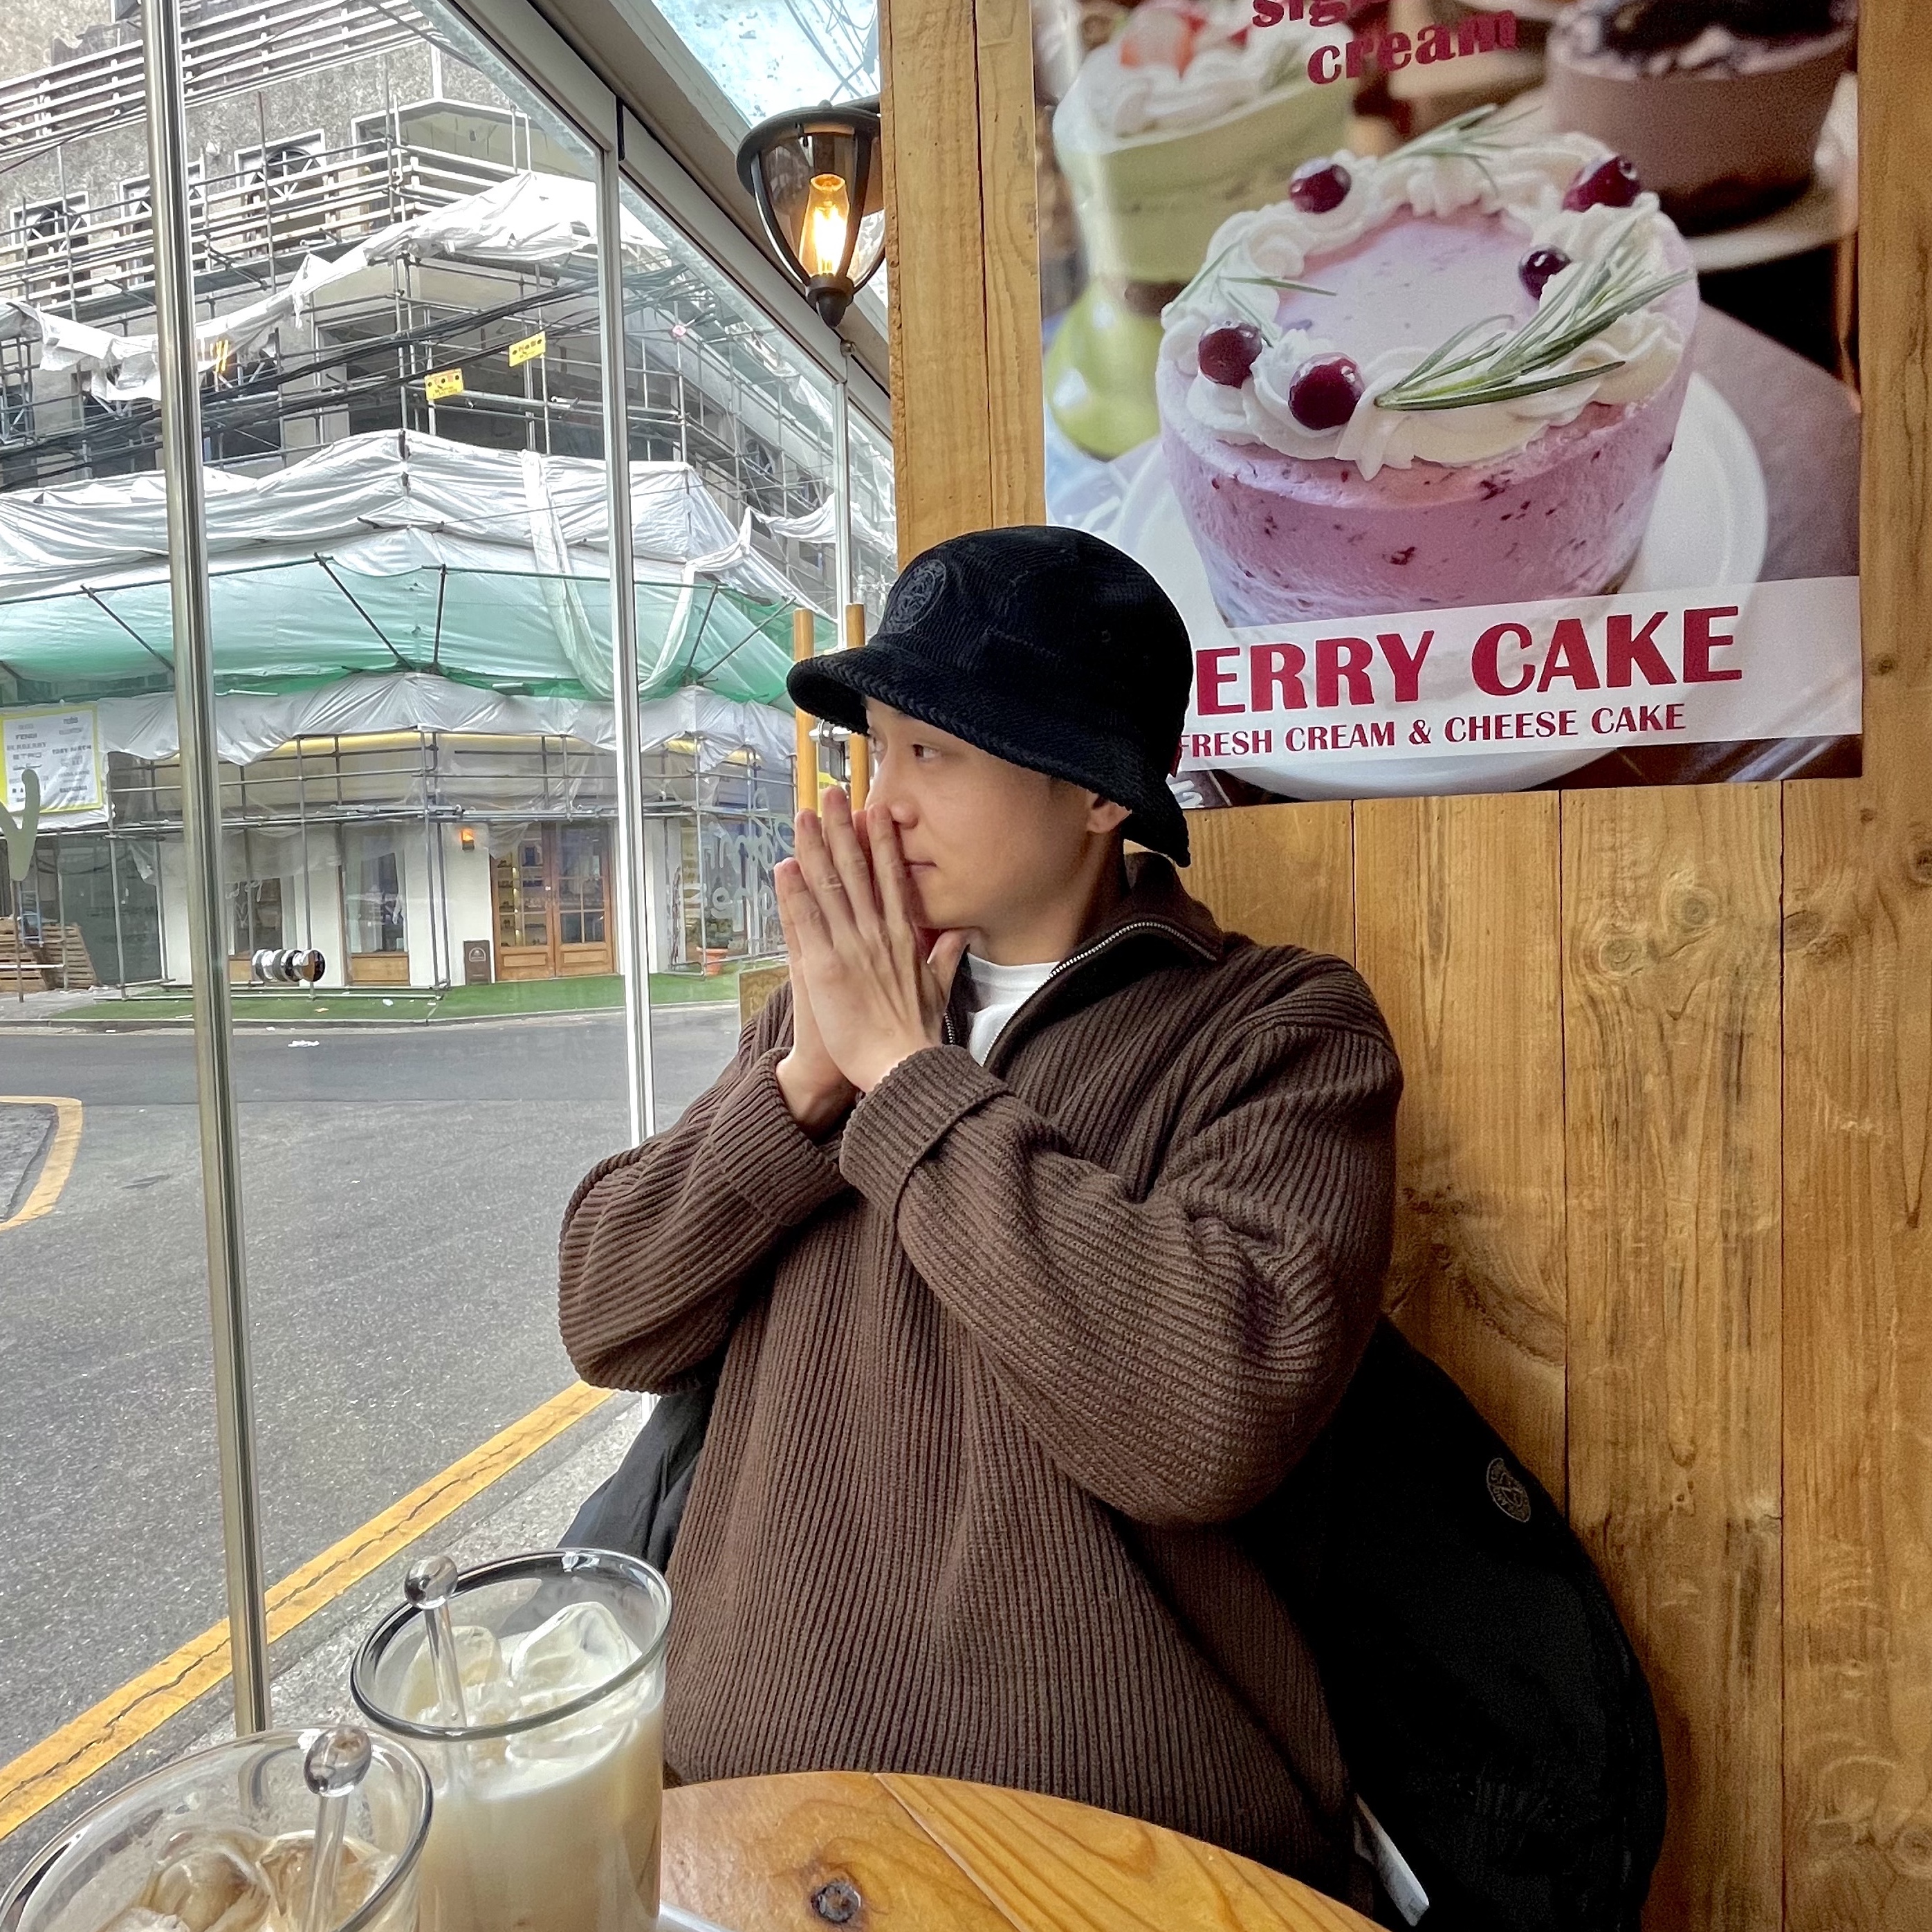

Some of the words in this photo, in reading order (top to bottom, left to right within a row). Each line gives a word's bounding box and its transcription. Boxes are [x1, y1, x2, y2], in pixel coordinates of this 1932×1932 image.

[1307, 10, 1518, 84] cream
[1196, 630, 1435, 715] ERRY
[1471, 605, 1742, 697] CAKE
[1285, 721, 1395, 753] CREAM
[1408, 719, 1432, 745] &
[1444, 710, 1579, 742] CHEESE
[1591, 703, 1686, 735] CAKE
